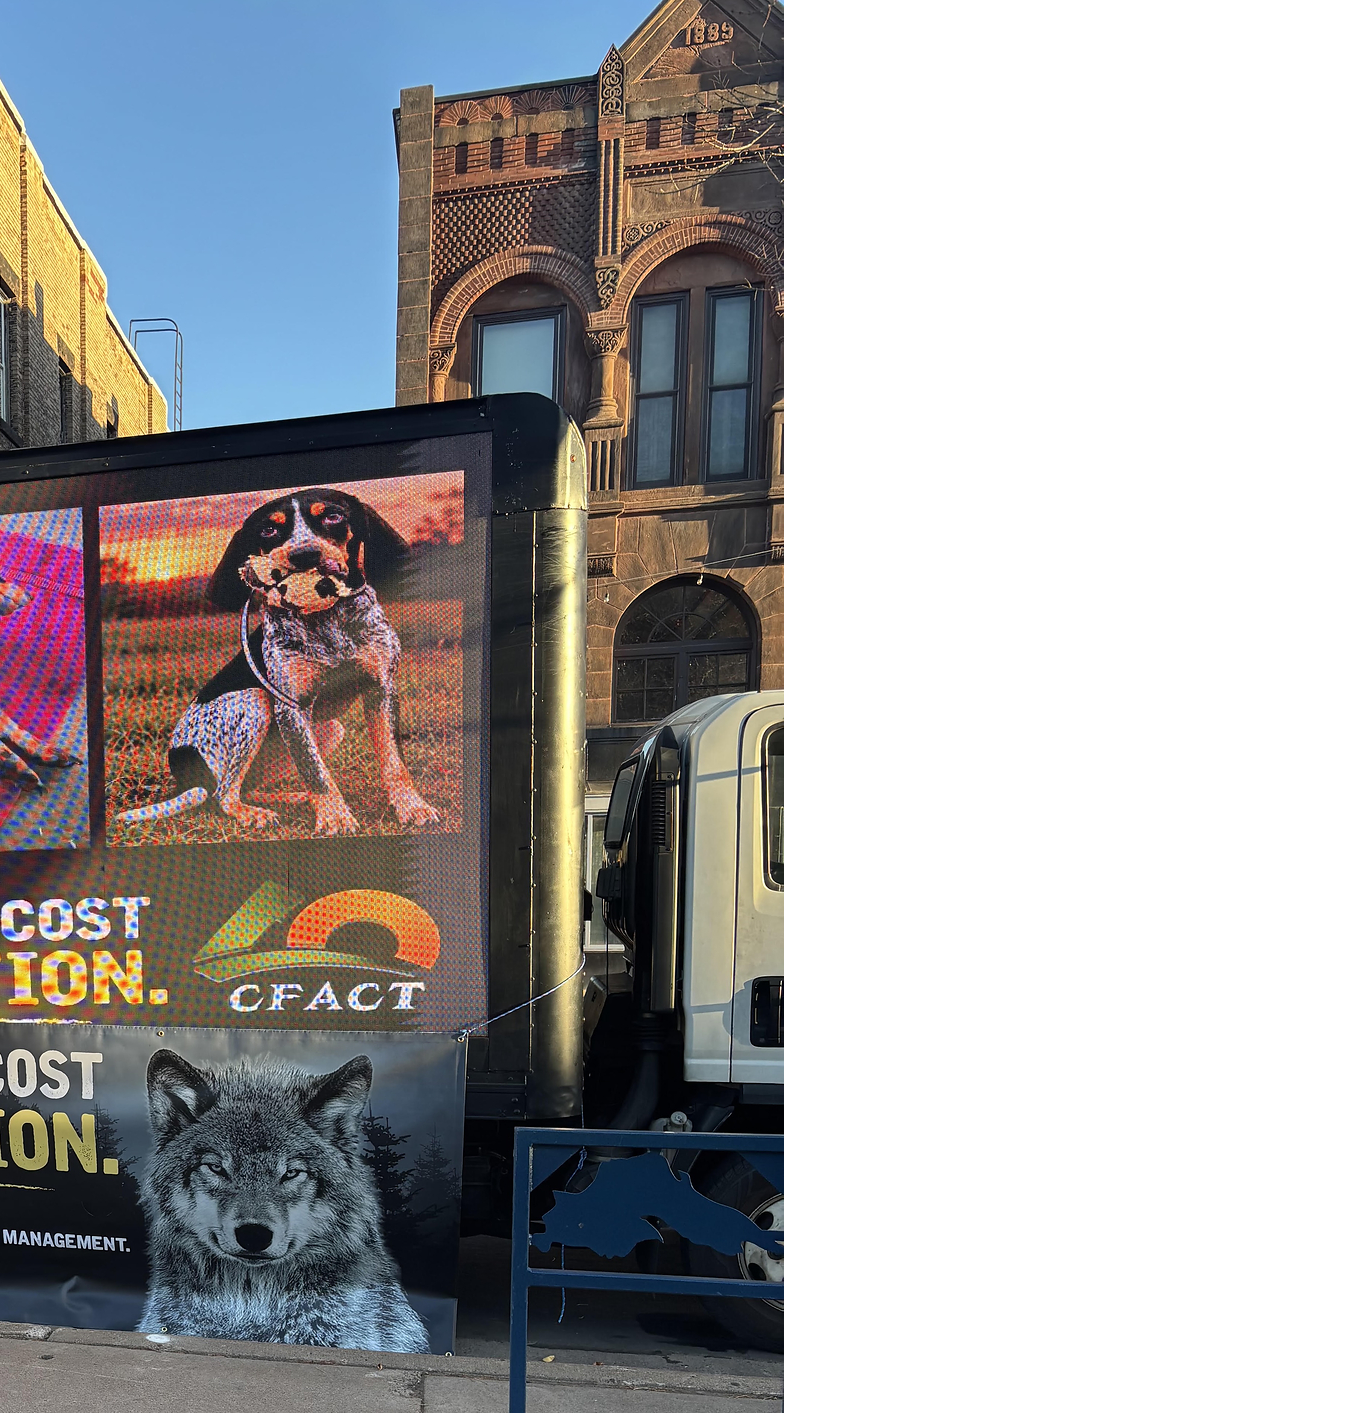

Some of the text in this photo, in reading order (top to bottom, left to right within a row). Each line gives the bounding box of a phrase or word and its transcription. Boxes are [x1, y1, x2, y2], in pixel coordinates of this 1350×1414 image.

[685, 21, 733, 45] 1889
[0, 896, 150, 942] COST
[228, 981, 426, 1013] CFACT
[2, 1228, 131, 1253] MANAGEMENT.
